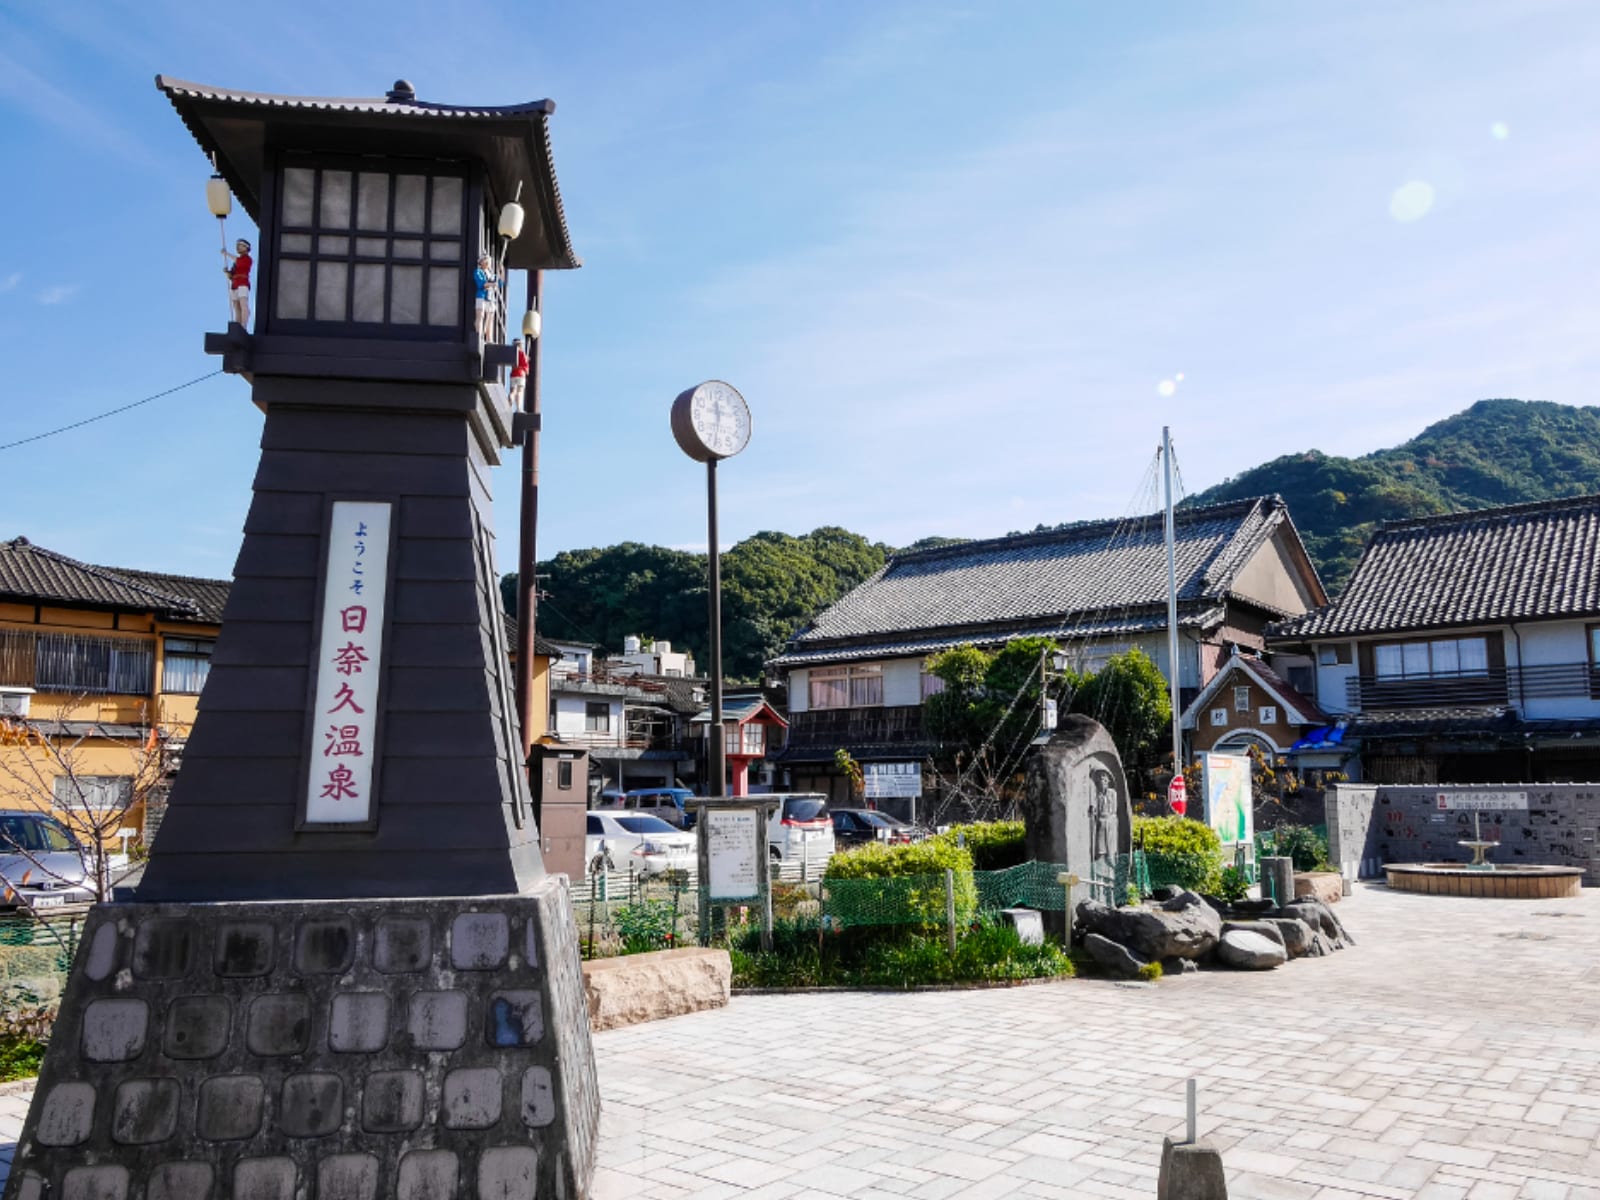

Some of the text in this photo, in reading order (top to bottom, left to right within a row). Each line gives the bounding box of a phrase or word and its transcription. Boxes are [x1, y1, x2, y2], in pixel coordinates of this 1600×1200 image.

[709, 390, 723, 401] 12
[698, 421, 705, 432] 8
[350, 522, 368, 594] ようこそ
[320, 606, 369, 801] 日奈久温泉
